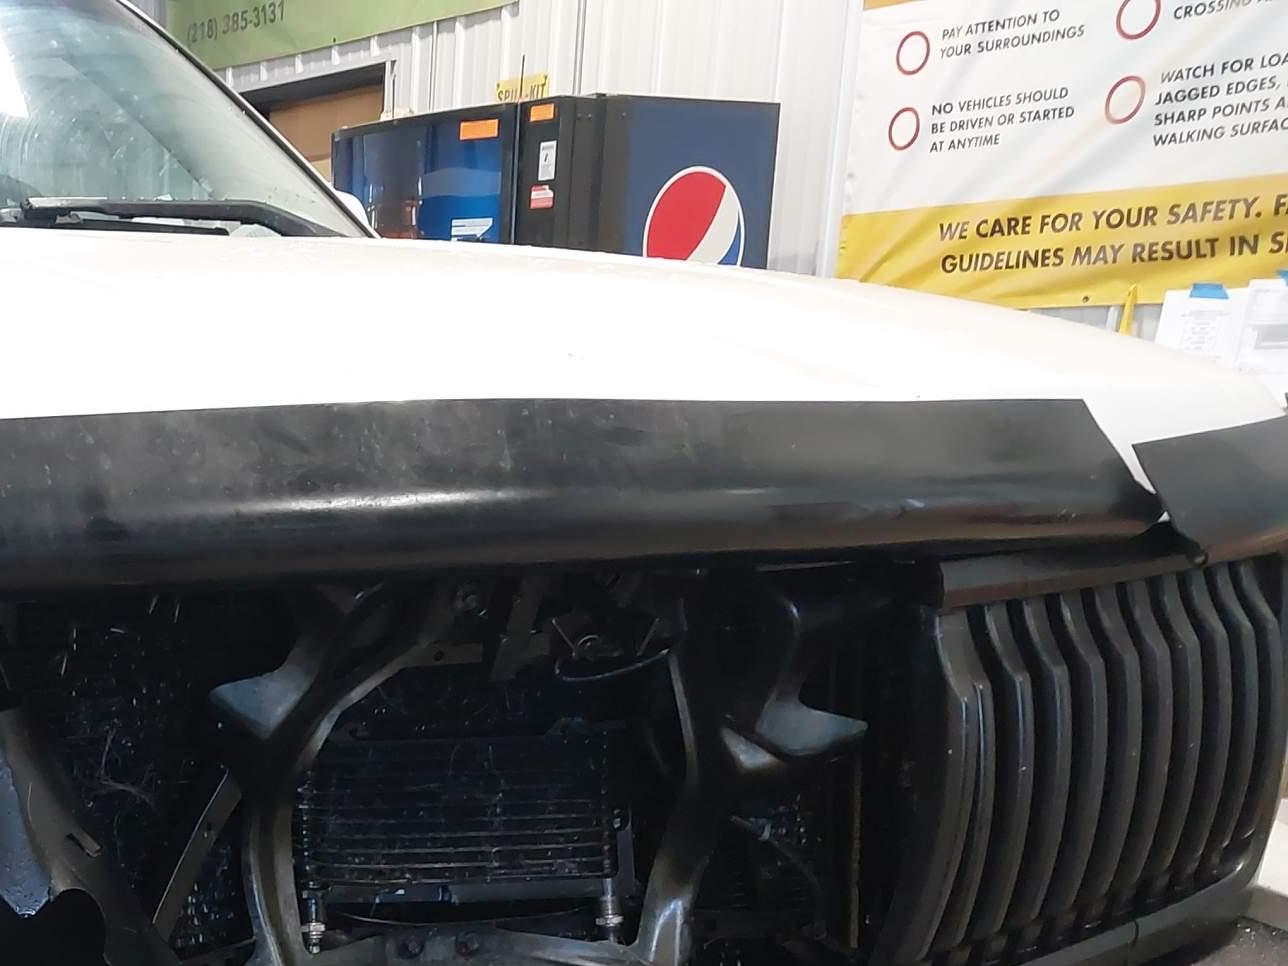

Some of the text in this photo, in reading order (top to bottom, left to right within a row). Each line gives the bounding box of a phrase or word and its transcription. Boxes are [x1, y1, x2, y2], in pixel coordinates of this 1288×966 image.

[187, 1, 284, 42] (218) 385-3131
[941, 9, 1060, 41] PAY ATTENTION TO
[940, 24, 1086, 59] YOUR SURROUNDINGS
[1160, 64, 1215, 84] WATCH
[1221, 58, 1254, 75] FOR
[931, 87, 1069, 116] NO VEHICLES SHOULD
[1154, 75, 1281, 106] JAGGED EDGES,
[930, 106, 1075, 134] BE DRIVEN OR STARTED
[1154, 96, 1288, 126] SHARP POINTS A
[929, 133, 1000, 153] AT ANYTIME
[1153, 126, 1226, 147] WALKING
[939, 193, 1288, 241] WE CARE FOR YOUR SAFETY. F
[941, 231, 1288, 274] GUIDELINES MAY RESULT IN S
